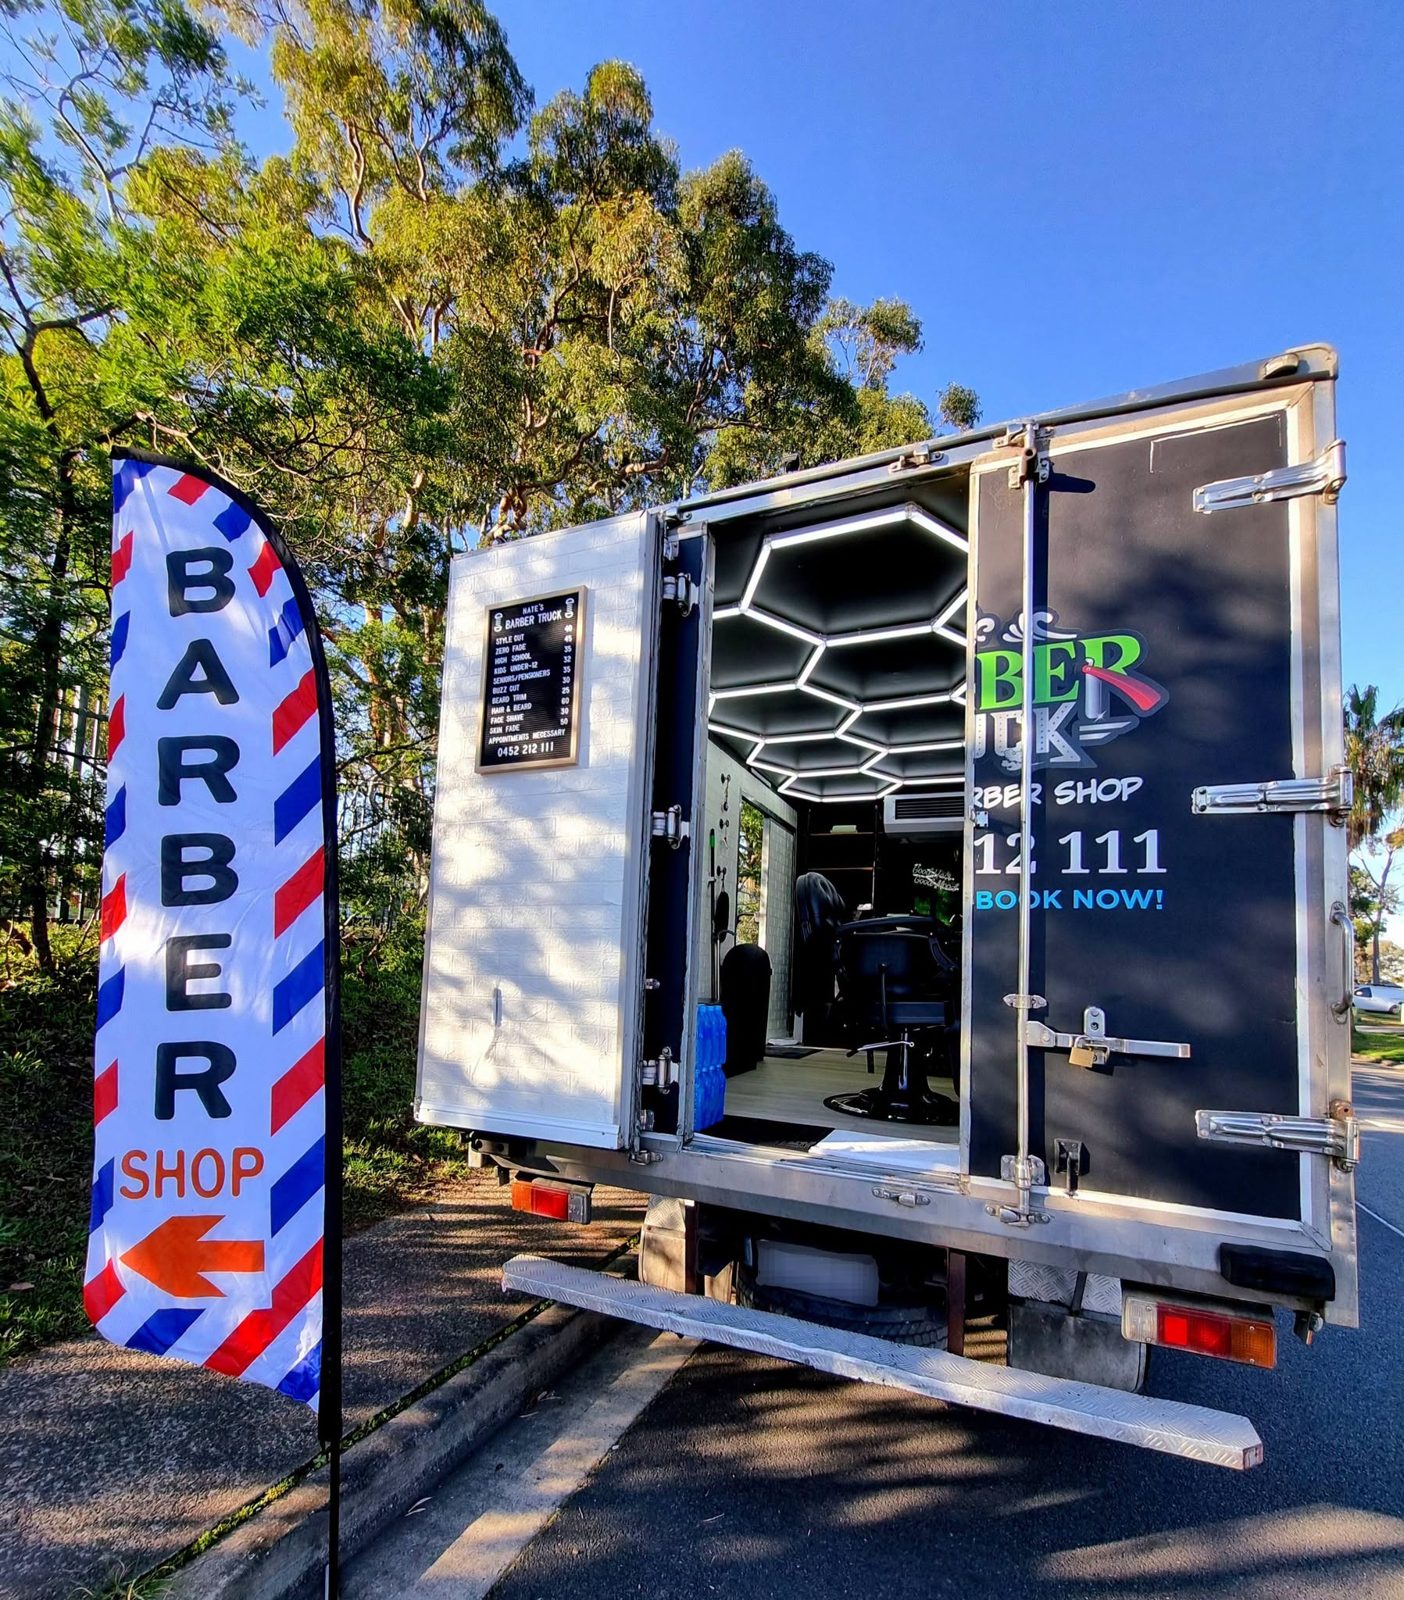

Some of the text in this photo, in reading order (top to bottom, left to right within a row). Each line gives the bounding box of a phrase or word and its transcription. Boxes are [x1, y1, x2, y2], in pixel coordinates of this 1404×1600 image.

[523, 603, 544, 615] NATE'S
[505, 610, 562, 630] BARBER TRUCK
[495, 634, 573, 655] ZERO FADE 45
[496, 635, 513, 645] STYLE
[513, 633, 525, 642] CUT
[493, 655, 572, 675] KIDS UNDER-12 32
[494, 645, 573, 665] HIGH SCHOOL 35
[493, 665, 571, 685] SENIORS/PENSIONERS 35
[492, 676, 571, 695] BUZZ CUT 30
[492, 686, 570, 704] BEARD TRIM 25
[490, 707, 569, 725] FACE SHAVE 30
[491, 706, 505, 715] HAIR
[513, 702, 532, 712] BEARD
[488, 728, 566, 745] APPOINTMENTS NECESSARY
[489, 718, 569, 735] SKIN FADE 50
[497, 741, 554, 758] 0452 212 111
[1054, 776, 1143, 805] SHOP
[156, 546, 240, 1120] BARBER
[1058, 829, 1167, 874] 111
[1073, 889, 1163, 910] NOW!
[119, 1147, 265, 1199] SHOP
